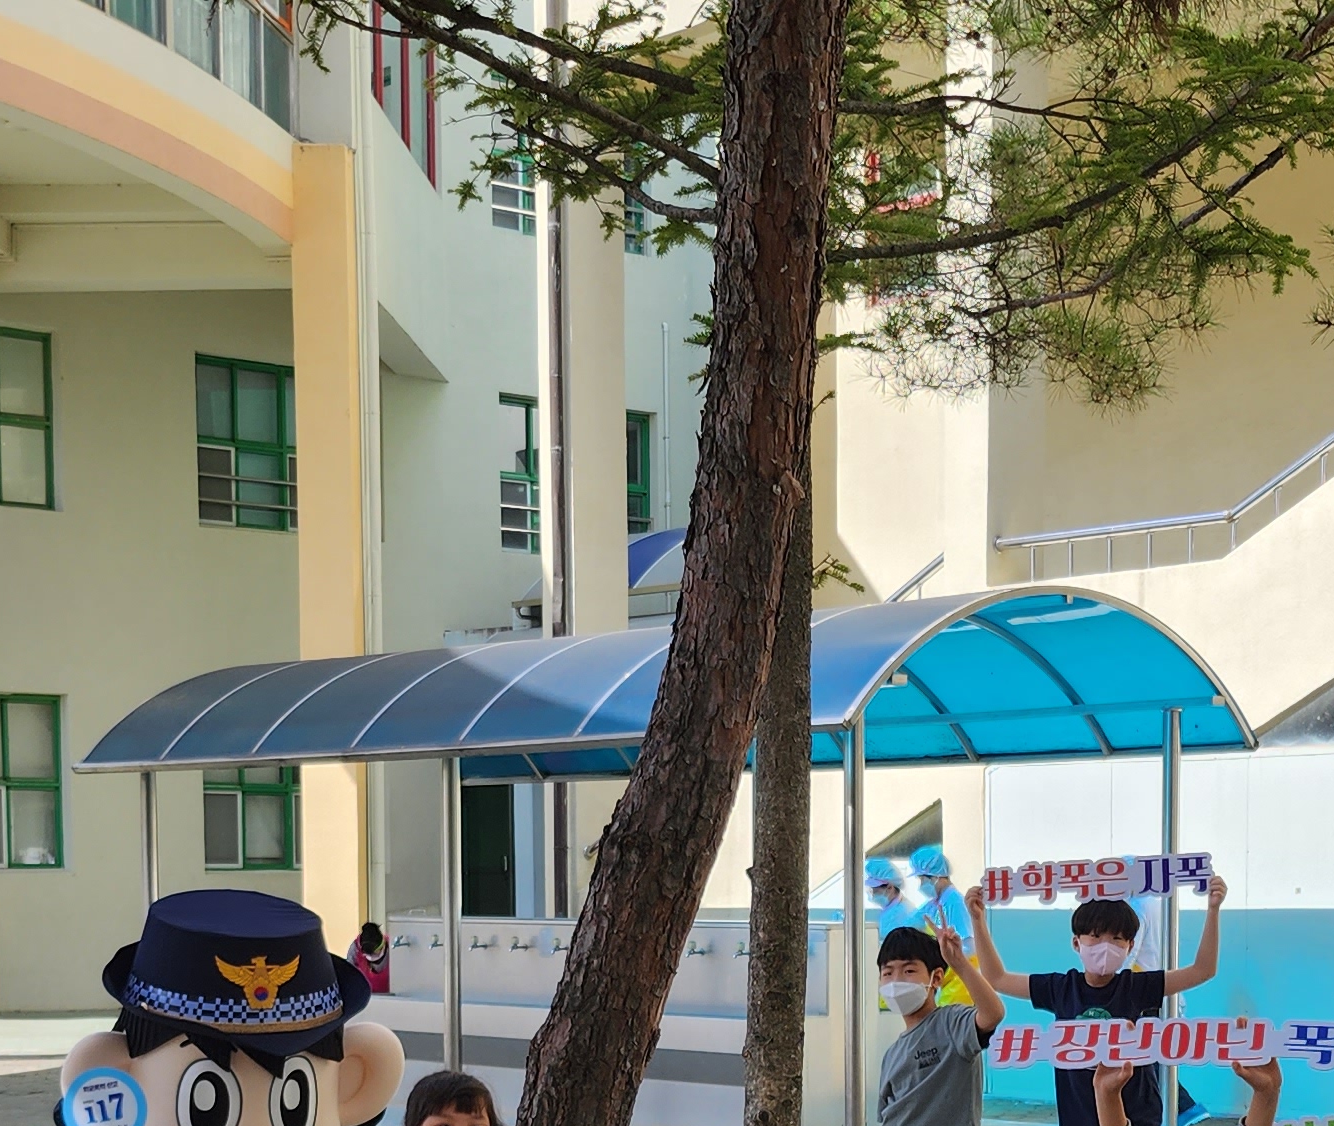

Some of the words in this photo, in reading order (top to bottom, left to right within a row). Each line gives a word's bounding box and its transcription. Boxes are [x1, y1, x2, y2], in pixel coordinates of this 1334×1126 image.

[1137, 856, 1212, 894] 자폭
[914, 1047, 938, 1060] Jeep
[1052, 1022, 1266, 1064] 장난아닌
[84, 1092, 124, 1124] 117
